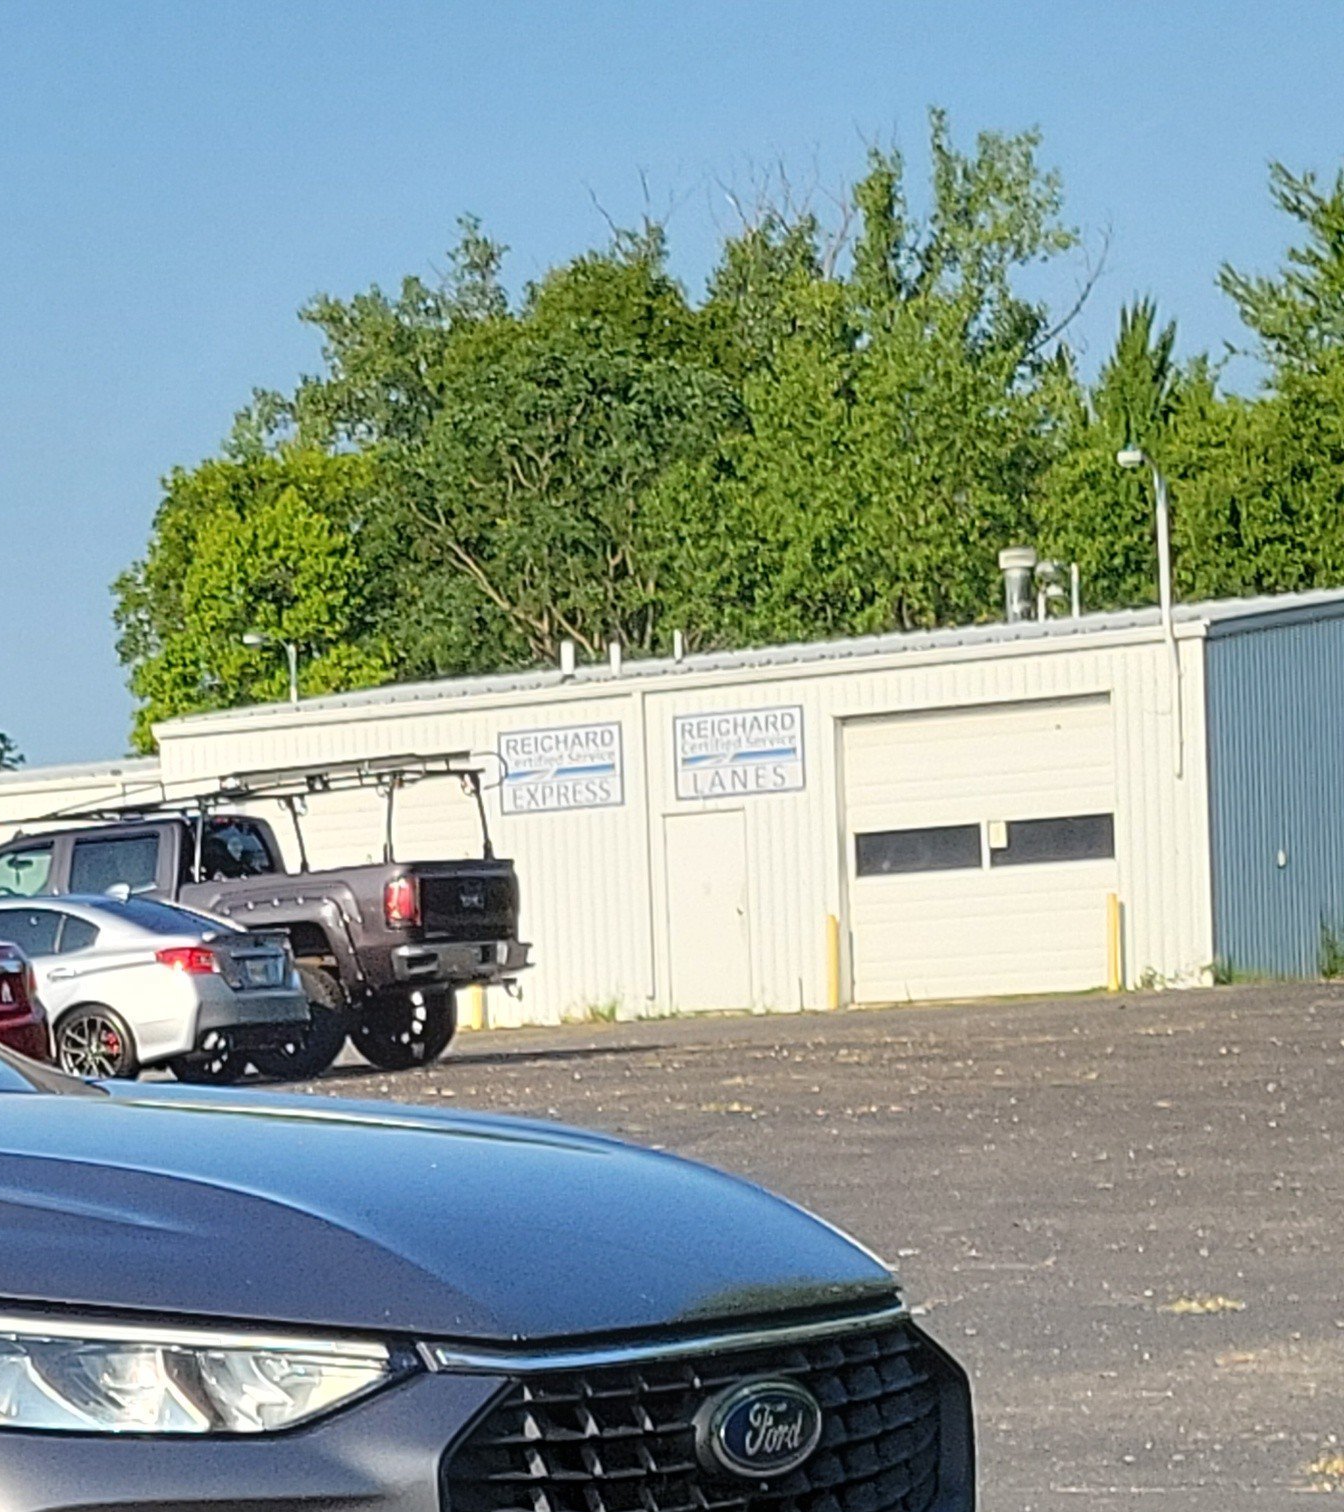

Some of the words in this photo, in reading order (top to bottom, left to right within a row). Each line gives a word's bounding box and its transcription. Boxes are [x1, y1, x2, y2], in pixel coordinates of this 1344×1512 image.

[681, 712, 796, 740] REICHARD
[506, 728, 615, 757] REICHARD
[512, 778, 611, 810] EXPRESS
[693, 764, 787, 795] LANES
[744, 1402, 803, 1456] Ford
